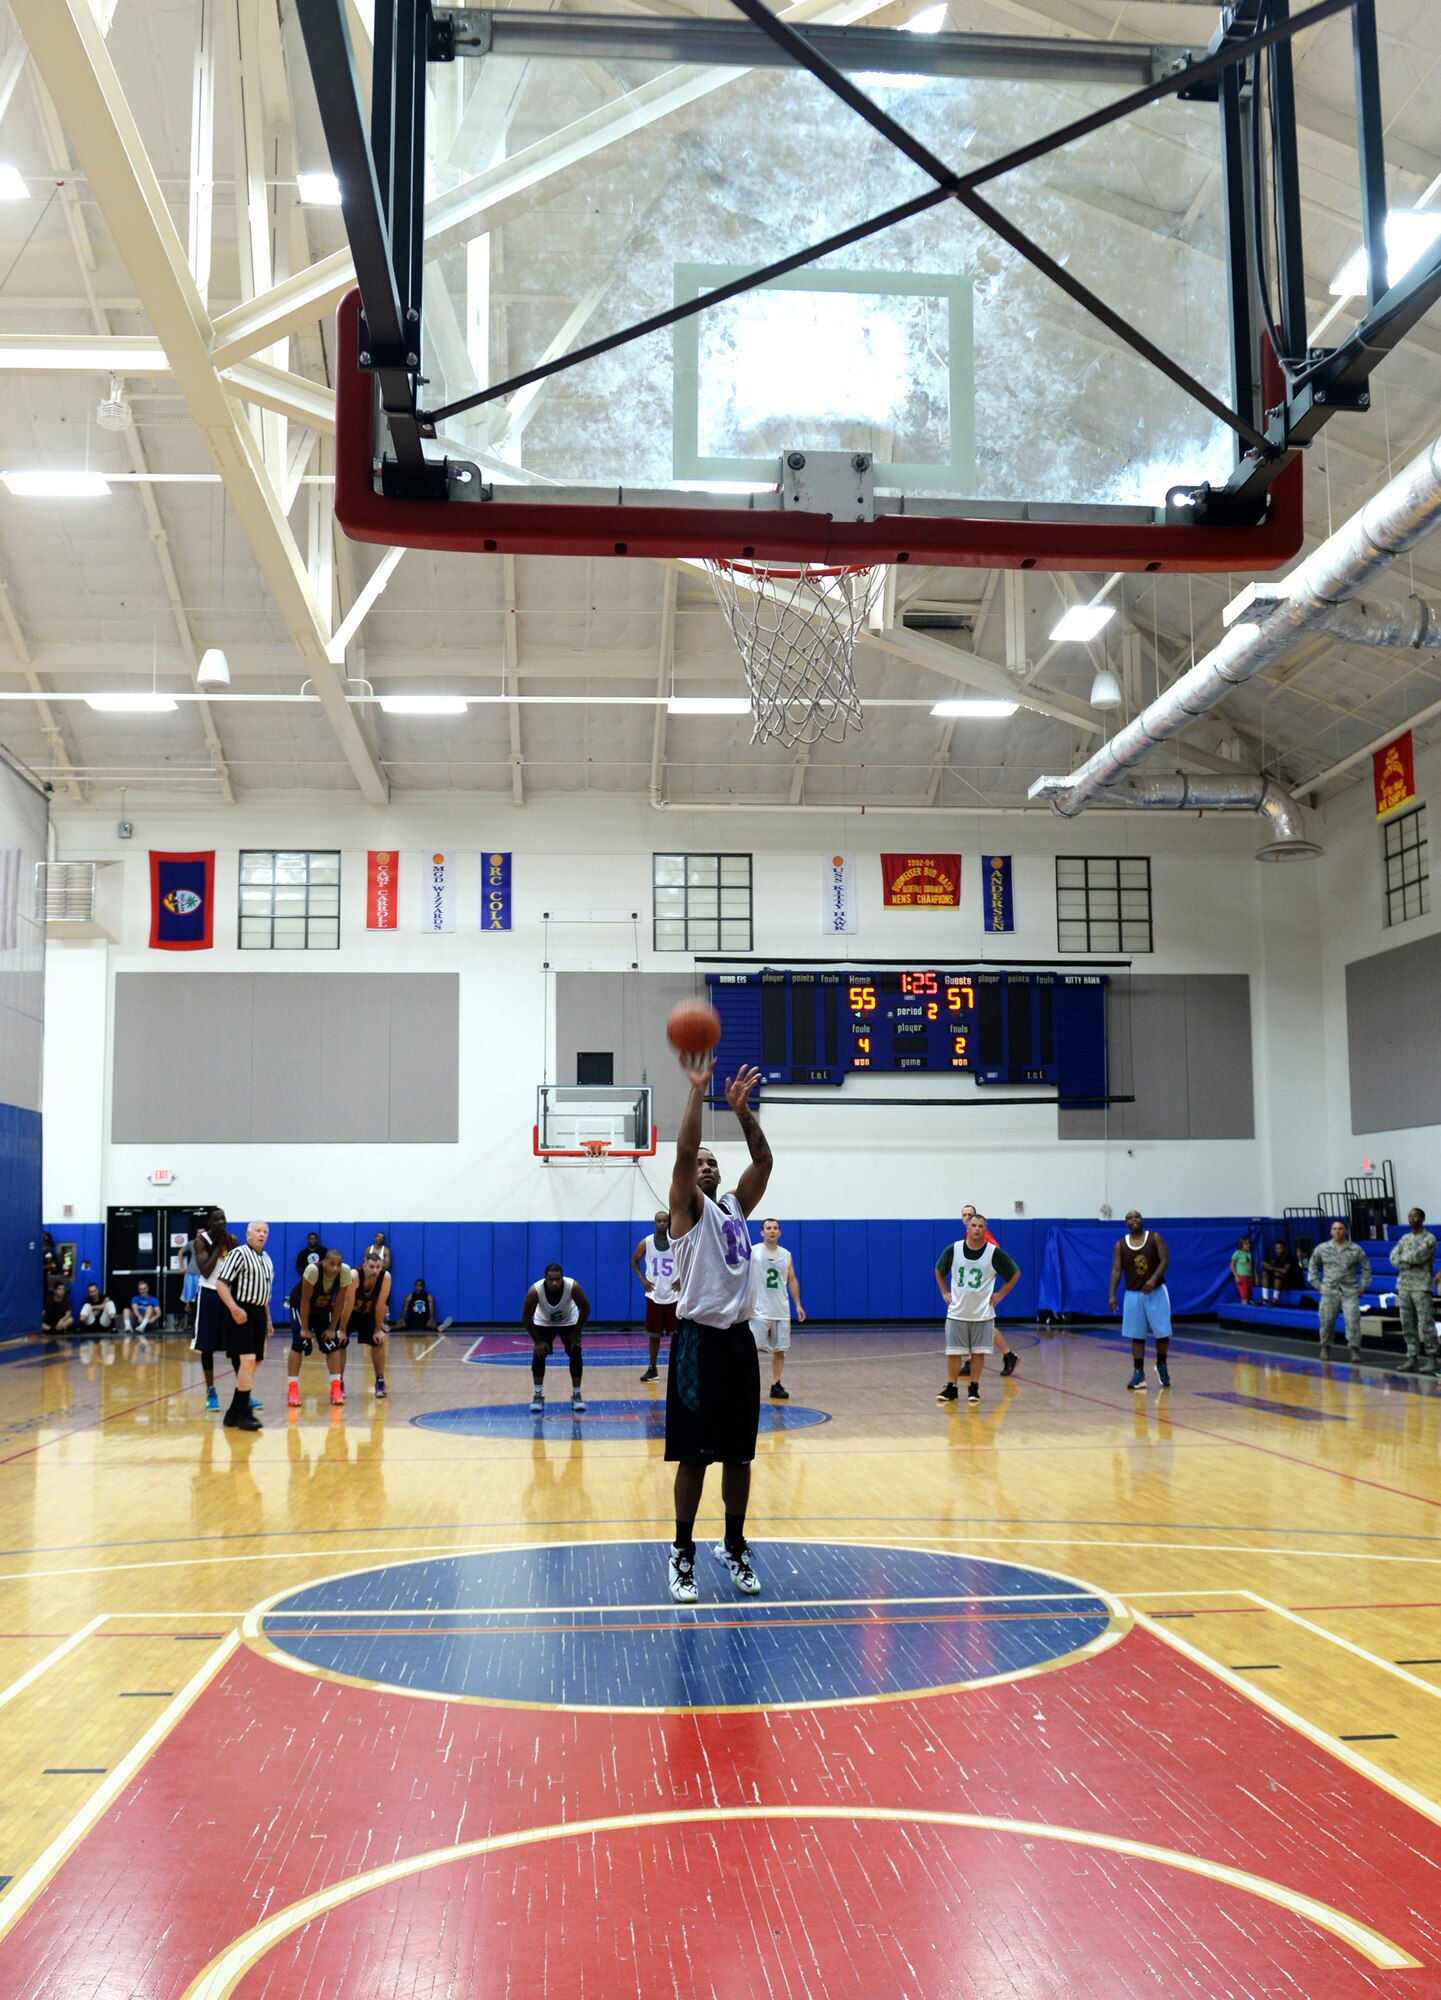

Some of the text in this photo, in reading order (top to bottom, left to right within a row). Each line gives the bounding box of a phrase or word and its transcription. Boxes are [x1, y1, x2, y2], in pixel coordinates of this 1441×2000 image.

[377, 865, 390, 887] CAMP
[433, 866, 445, 883] MGD
[891, 867, 922, 892] BUDWEISER
[924, 867, 938, 878] BUD
[938, 873, 955, 892] BASH
[489, 867, 503, 929] RC COLA
[916, 894, 954, 904] CHAMPIONS
[991, 870, 1004, 931] ANDERSEN
[762, 975, 785, 984] player
[791, 974, 815, 983] points
[820, 974, 840, 984] fouls
[849, 975, 871, 984] Home
[901, 972, 938, 995] 1:25
[944, 976, 972, 985] Guests
[1036, 975, 1055, 985] fouls
[849, 987, 877, 1010] 55
[946, 987, 975, 1010] 57
[897, 1006, 923, 1017] period
[927, 1002, 939, 1020] 2
[851, 1023, 871, 1034] fouls
[897, 1023, 923, 1035] player
[949, 1023, 969, 1034] fouls
[858, 1038, 870, 1053] 4
[954, 1037, 966, 1055] 2
[854, 1058, 870, 1067] won
[901, 1058, 922, 1068] game
[952, 1058, 969, 1067] won
[651, 1257, 674, 1277] 15
[766, 1267, 779, 1289] 2
[957, 1266, 983, 1289] 13
